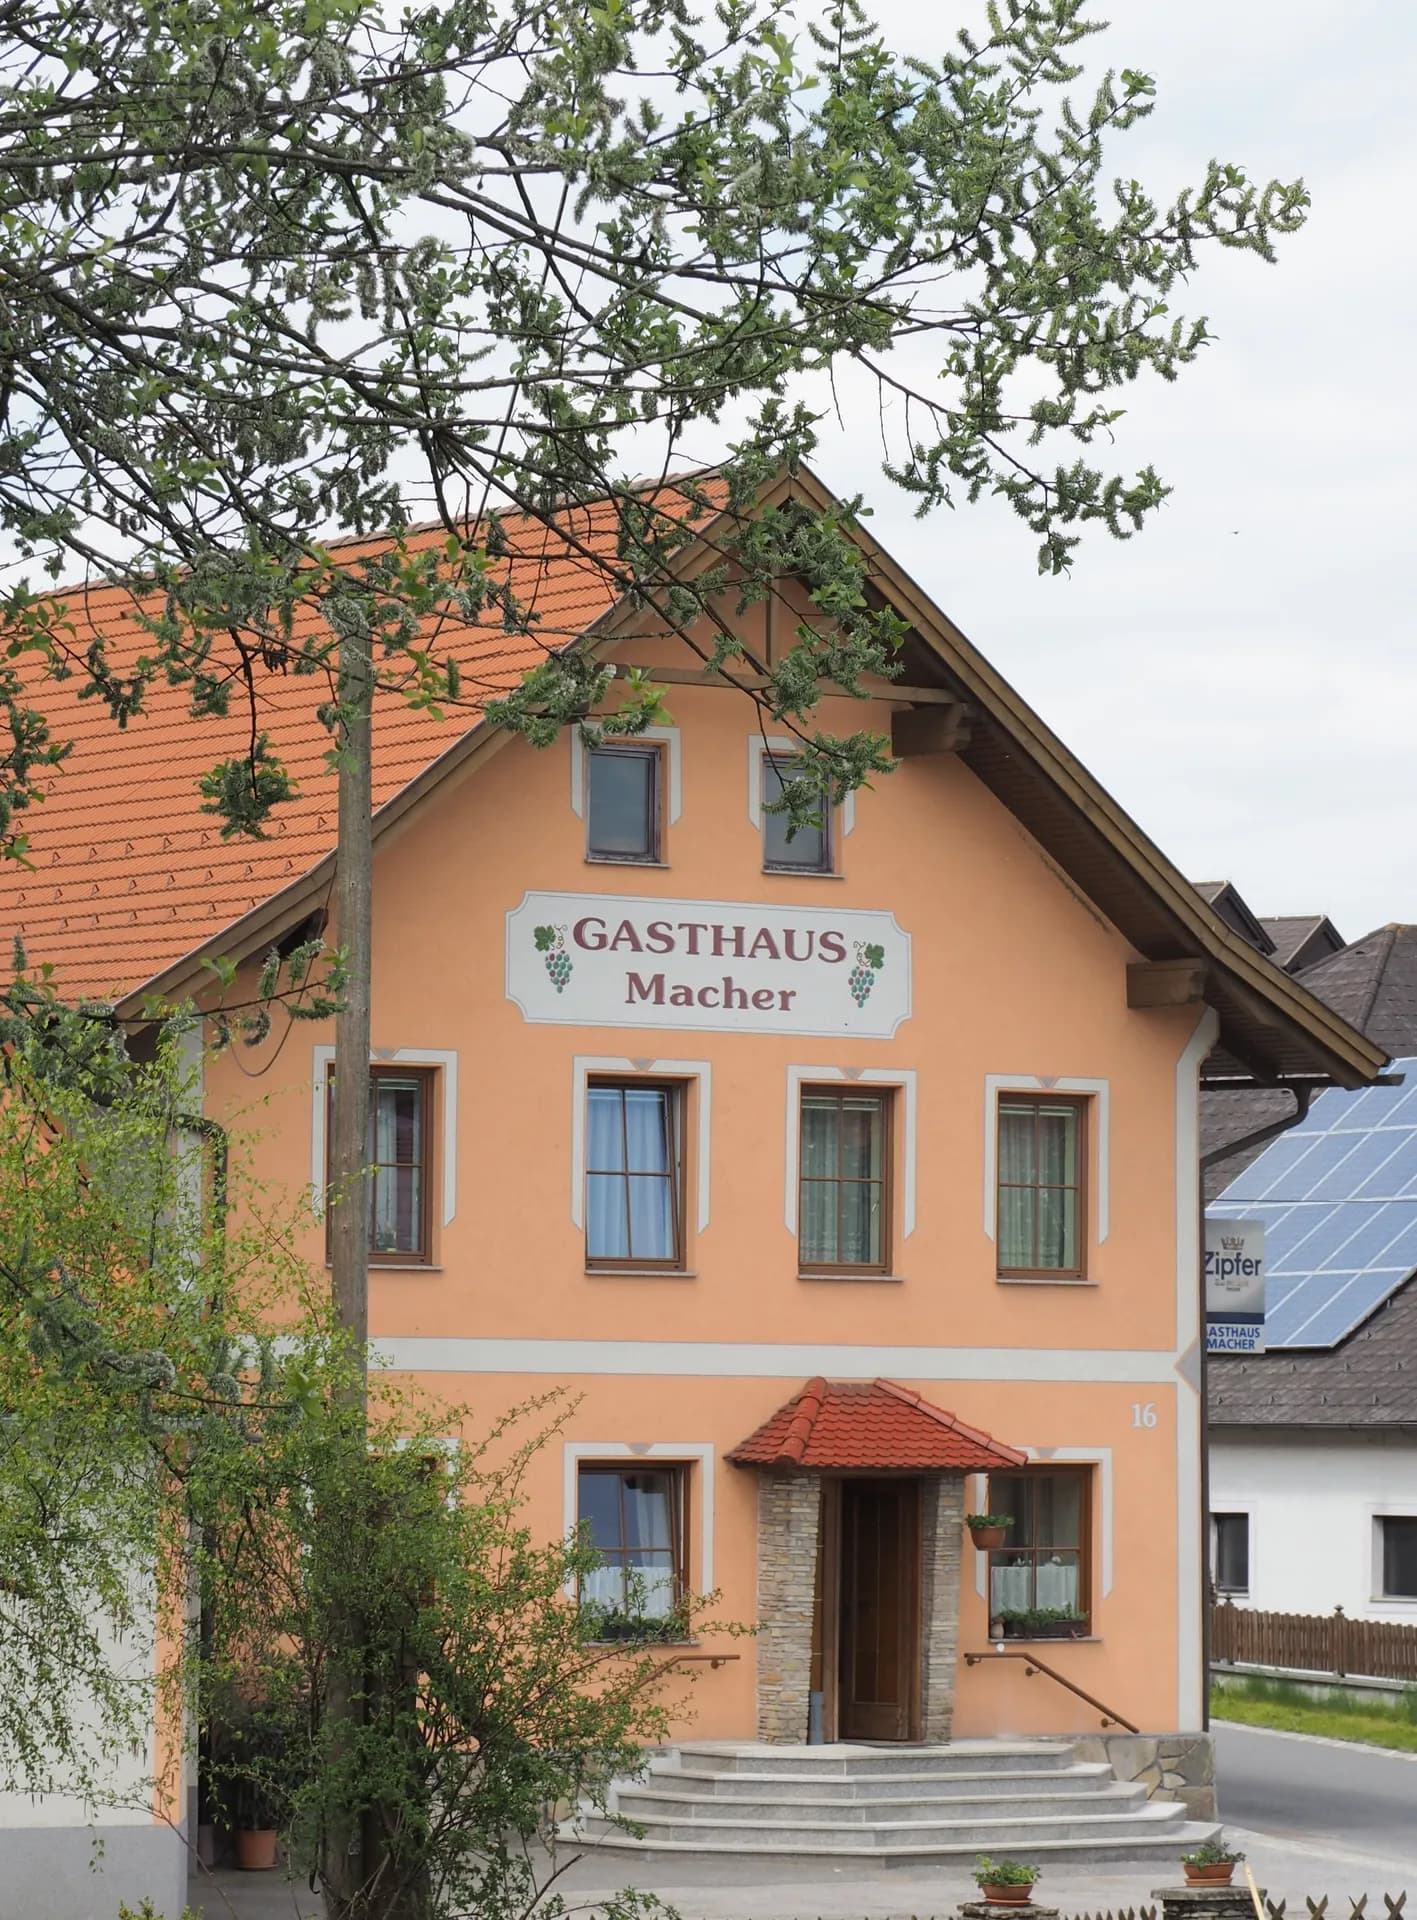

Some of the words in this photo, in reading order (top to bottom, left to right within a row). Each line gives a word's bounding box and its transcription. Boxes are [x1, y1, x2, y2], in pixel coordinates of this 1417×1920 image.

[572, 917, 847, 963] GASTHAUS
[625, 971, 797, 1011] Macher
[1205, 1251, 1261, 1280] Zipfer
[1206, 1338, 1255, 1350] MACHER
[1207, 1326, 1260, 1338] ASTHAUS
[1130, 1402, 1157, 1429] 16
